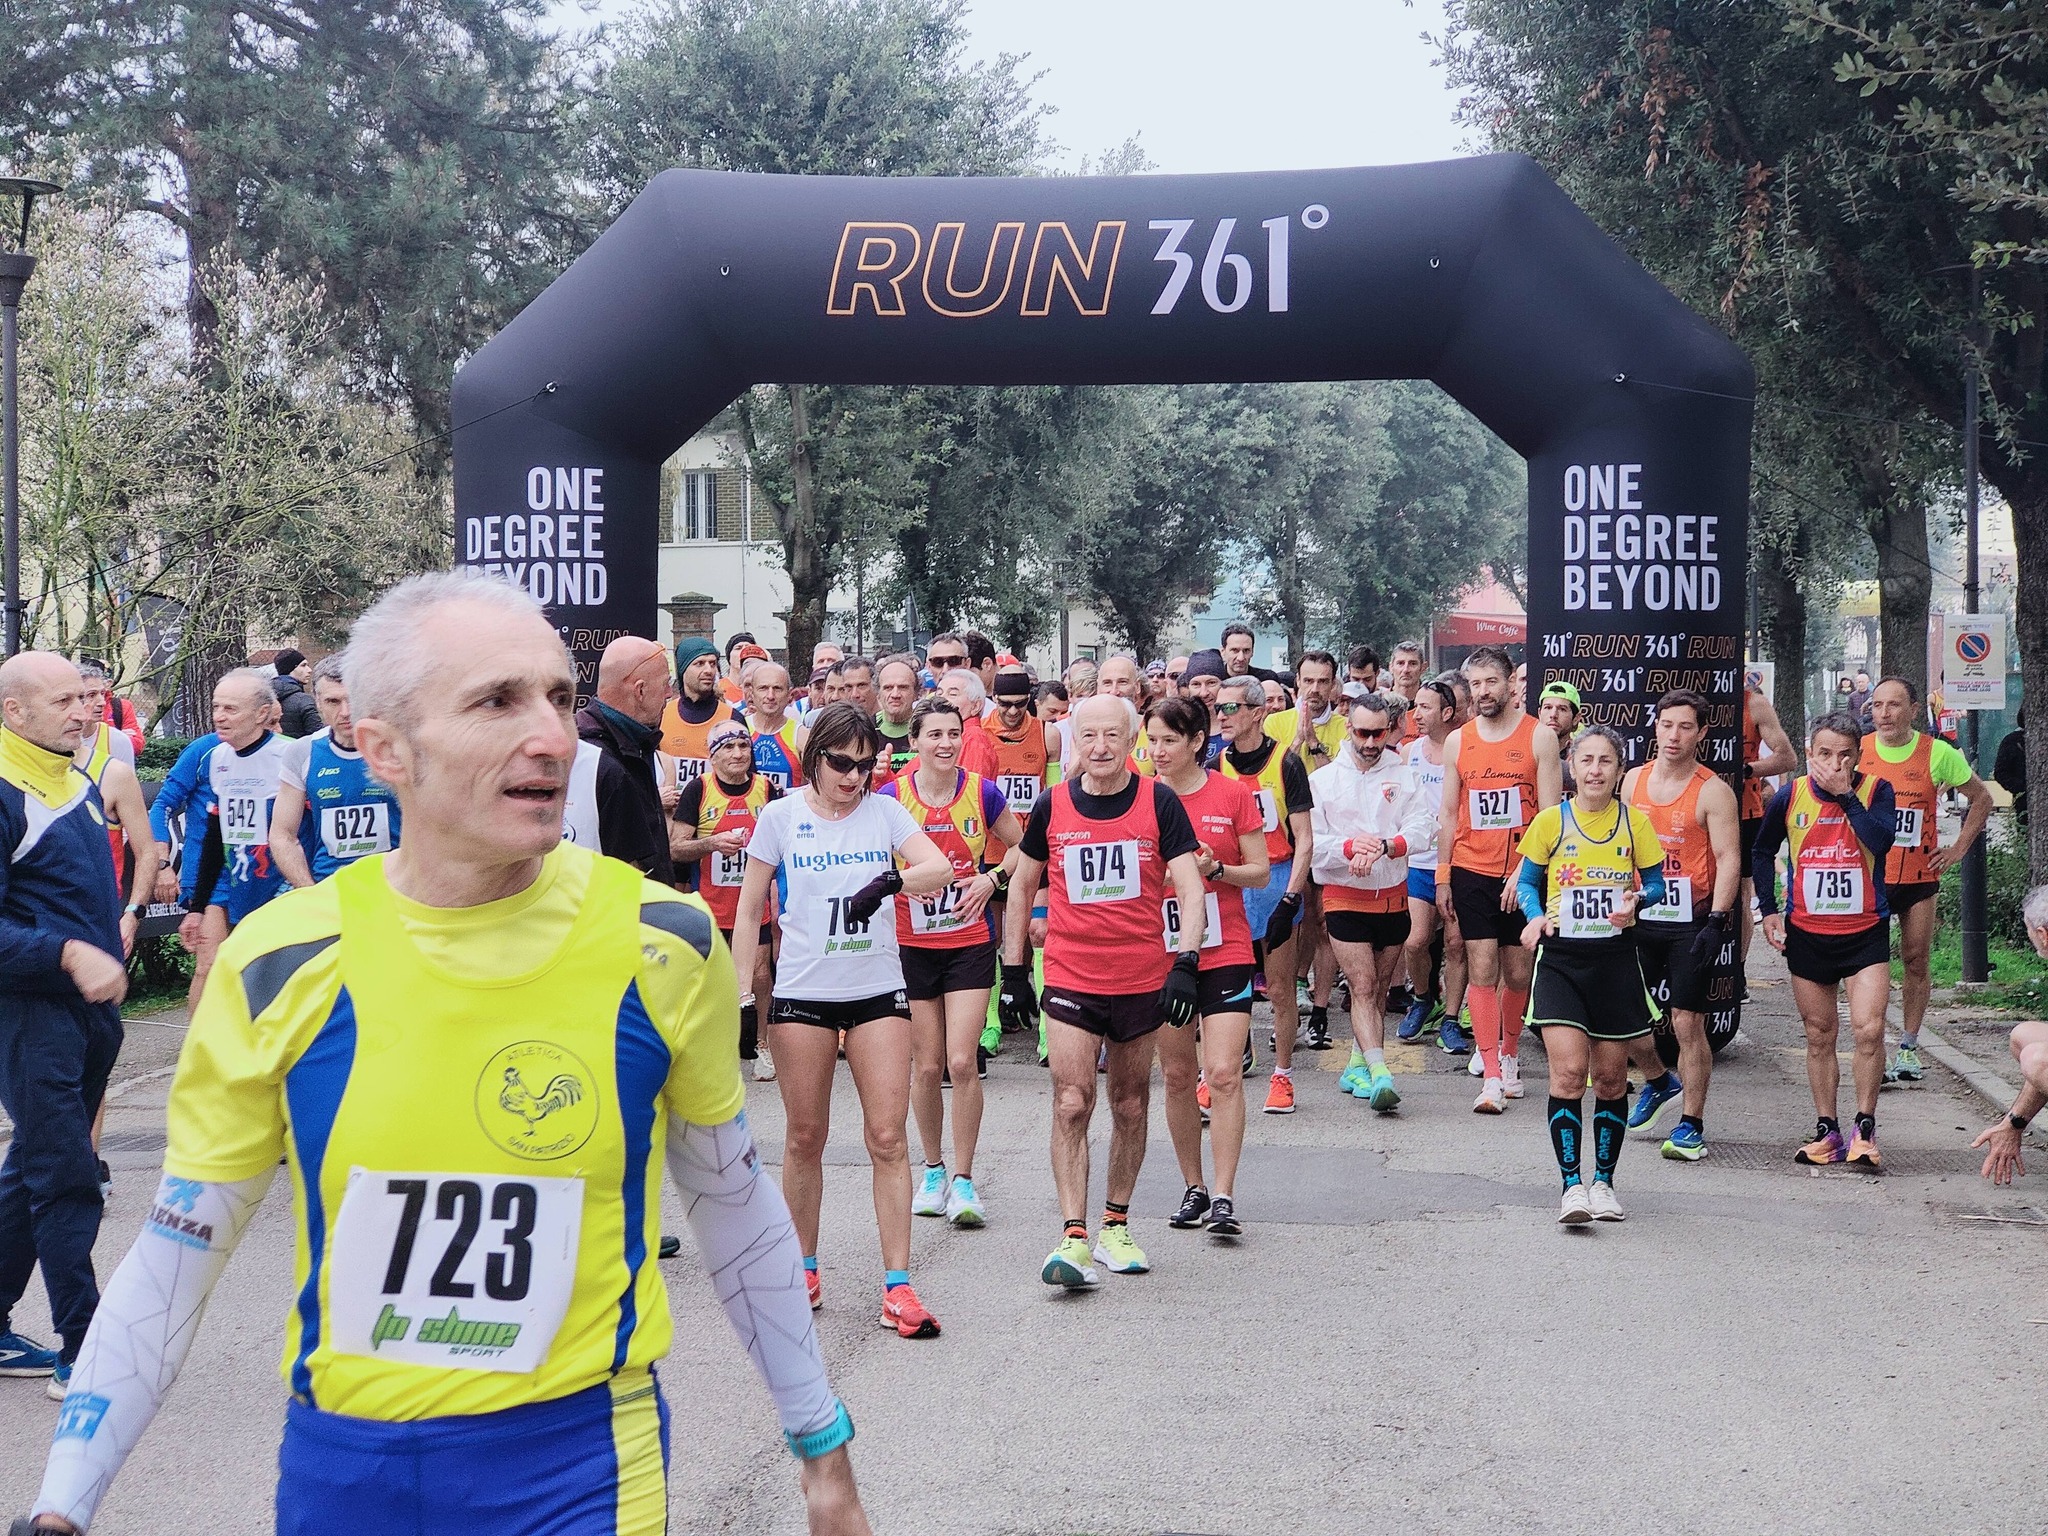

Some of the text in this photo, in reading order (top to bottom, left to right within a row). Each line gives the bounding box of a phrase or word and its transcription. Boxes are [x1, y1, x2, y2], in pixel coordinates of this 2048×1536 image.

[826, 204, 1330, 317] RUN 361°
[527, 467, 604, 511] ONE
[1564, 464, 1642, 511] ONE
[466, 514, 604, 560] DEGREE
[1564, 514, 1719, 562] DEGREE
[1564, 565, 1721, 611] BEYOND
[1542, 632, 1737, 660] 361° RUN 361° RUN
[1601, 666, 1645, 693] 361°
[1646, 669, 1711, 693] RUN
[1713, 668, 1738, 694] 361°
[1713, 735, 1737, 761] 361°
[1005, 777, 1033, 800] 755
[1481, 767, 1524, 780] Lamone
[228, 798, 256, 828] 542
[1478, 790, 1509, 816] 527
[334, 806, 377, 840] 622
[1056, 830, 1091, 840] macron
[792, 848, 889, 872] lughesina
[1080, 844, 1125, 882] 674
[1815, 871, 1852, 899] 735
[1572, 889, 1614, 920] 655
[381, 1178, 539, 1301] 723
[448, 1346, 507, 1358] SPORT
